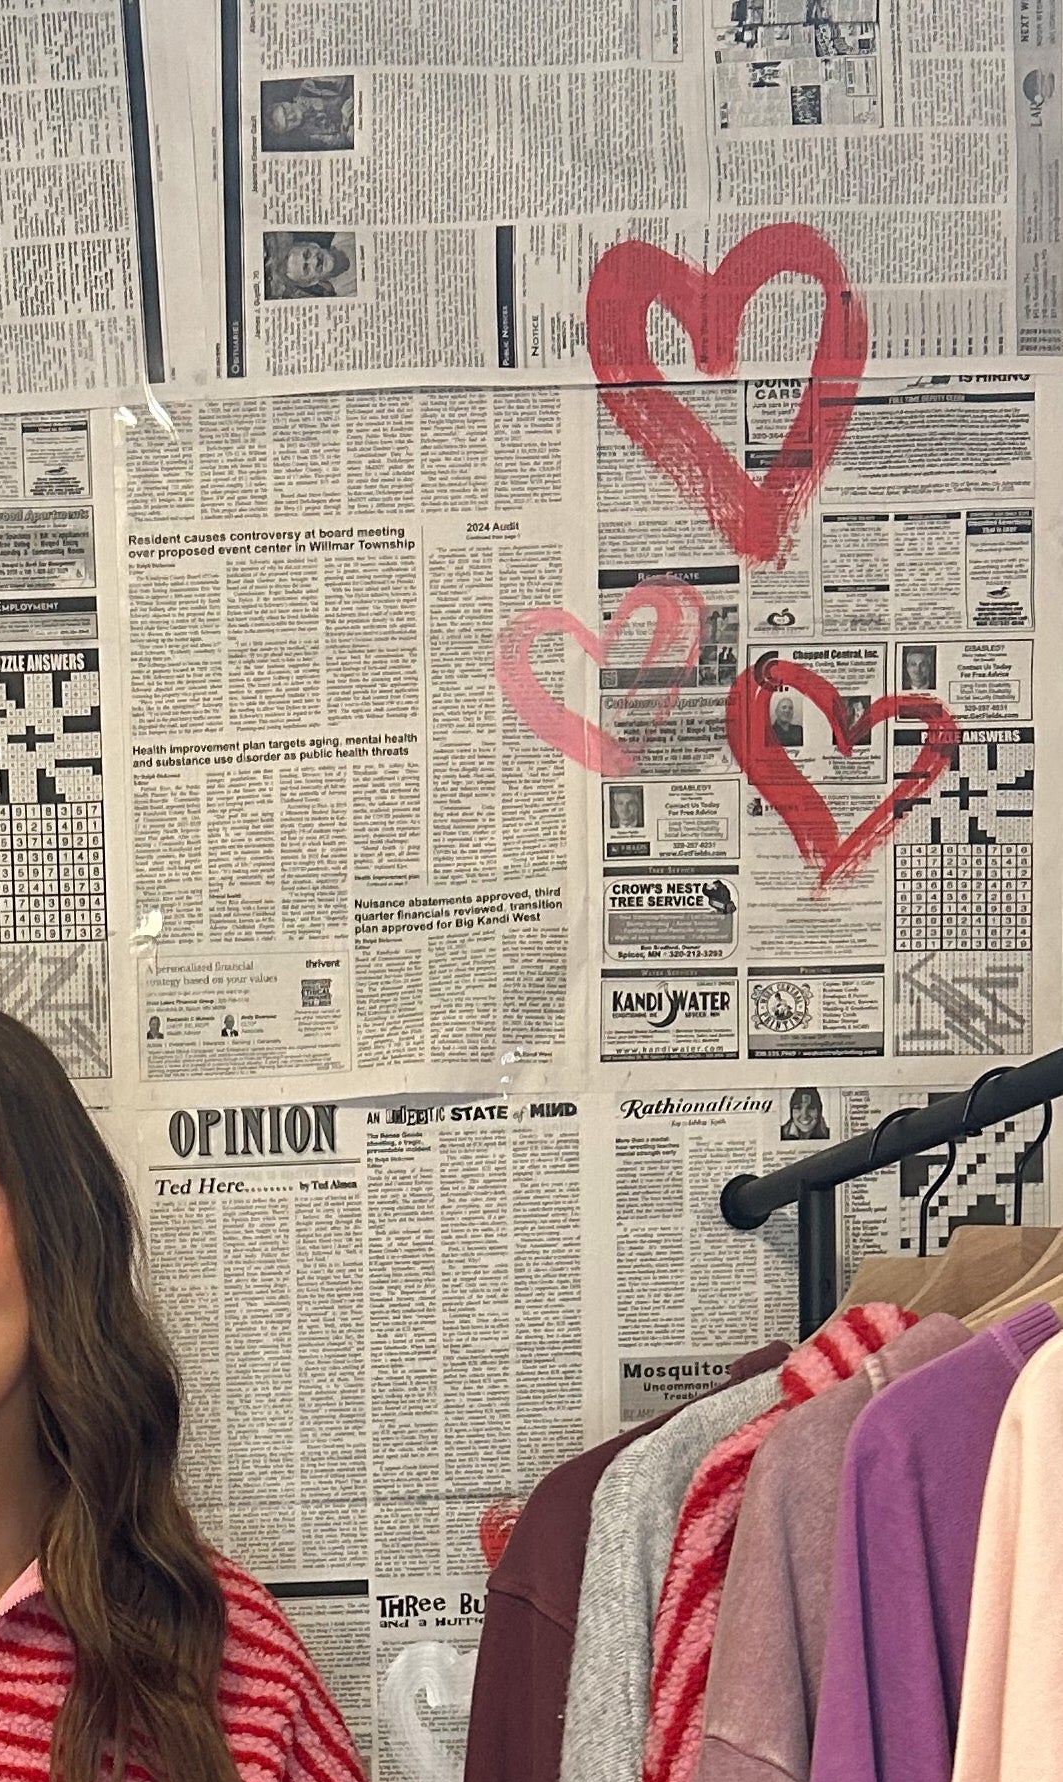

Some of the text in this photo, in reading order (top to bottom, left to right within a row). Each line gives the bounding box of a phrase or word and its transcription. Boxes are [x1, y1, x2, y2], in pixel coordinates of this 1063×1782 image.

[754, 388, 802, 400] CARS
[127, 526, 405, 545] Resident causes controversy at board meeting
[466, 521, 519, 532] 2024 Audit
[127, 538, 415, 559] over proposed event center in Willmar Township
[26, 652, 84, 671] ANSWERS
[132, 732, 417, 755] Health improvement plan targets aging, mental health
[962, 729, 1020, 744] ANSWERS
[132, 746, 408, 768] and substance use disorder as public health threats
[354, 886, 561, 909] Nuisance abatements approved, third
[611, 882, 705, 895] CROW'S NEST
[608, 894, 707, 907] TREE SERVICE
[354, 899, 563, 923] quarter financials reviewed, transition
[354, 912, 540, 935] plan approved for Big Kandi West
[305, 958, 340, 968] thrivent
[612, 991, 731, 1012] KANDI WATER
[366, 1110, 380, 1124] AN
[450, 1105, 508, 1121] STATE
[529, 1102, 577, 1117] MIND
[168, 1104, 337, 1156] OPINION
[154, 1178, 191, 1195] Ted
